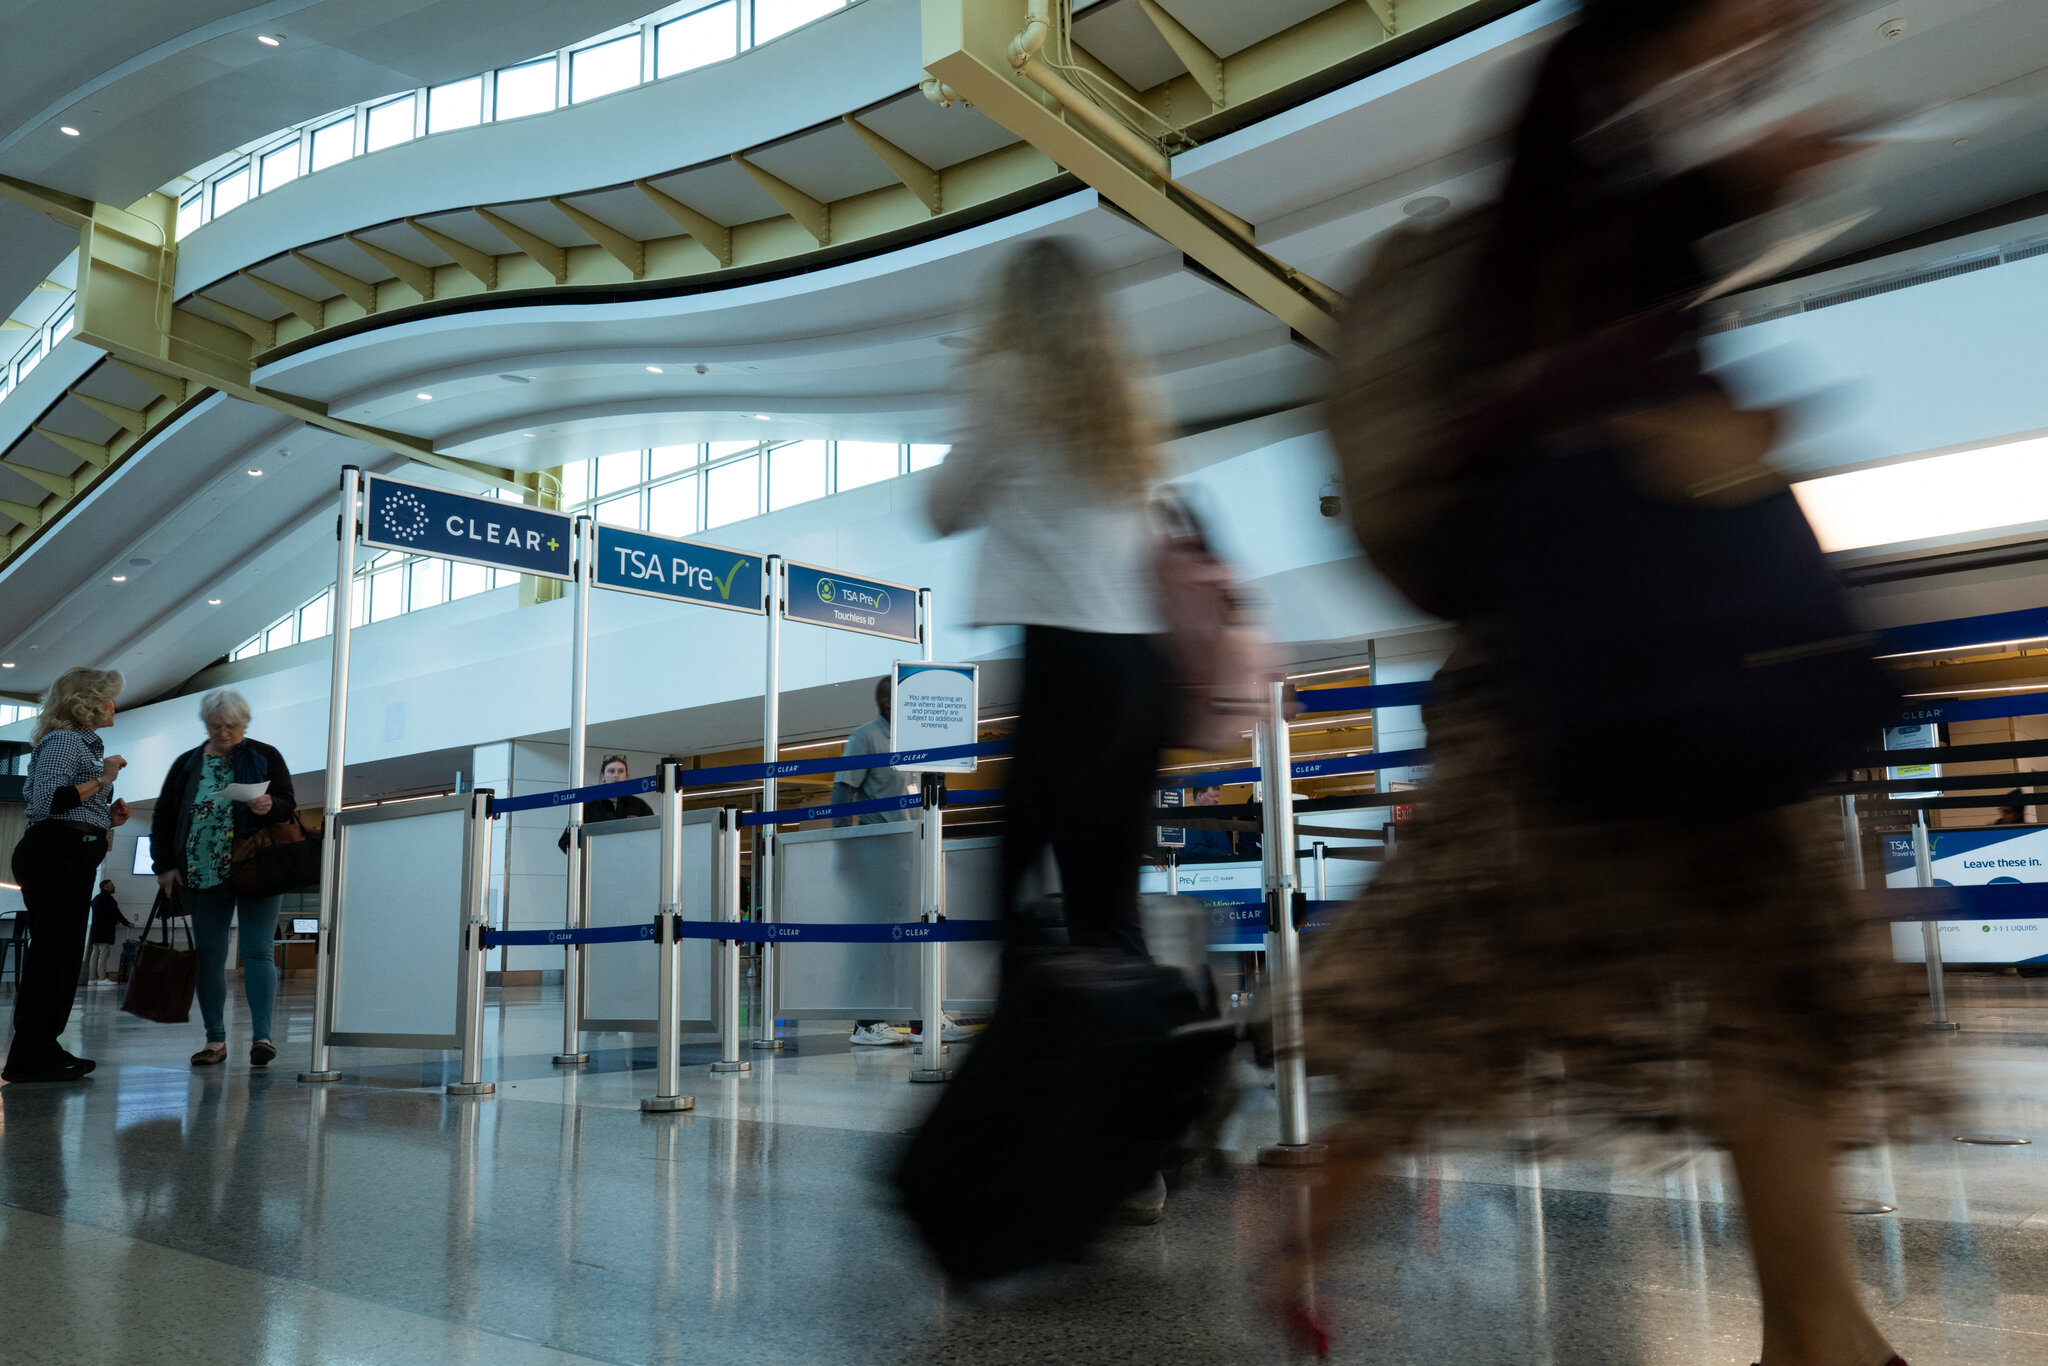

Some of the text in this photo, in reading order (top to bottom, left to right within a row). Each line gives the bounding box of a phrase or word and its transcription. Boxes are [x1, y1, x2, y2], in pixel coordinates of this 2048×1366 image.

[614, 546, 665, 583] TSA
[842, 589, 858, 602] TSA
[834, 609, 876, 626] Touchless ID
[906, 714, 927, 722] subject
[1902, 709, 1941, 720] CLEAR
[903, 753, 927, 762] CLEAR
[777, 765, 799, 773] CLEAR
[1295, 765, 1320, 773] CLEAR
[560, 793, 576, 801] CLEAR
[1889, 840, 1909, 850] TSA
[1963, 857, 2042, 869] Leave these in.
[1229, 909, 1261, 920] CLEAR
[557, 933, 572, 941] CLEAR
[905, 929, 929, 937] CLEAR
